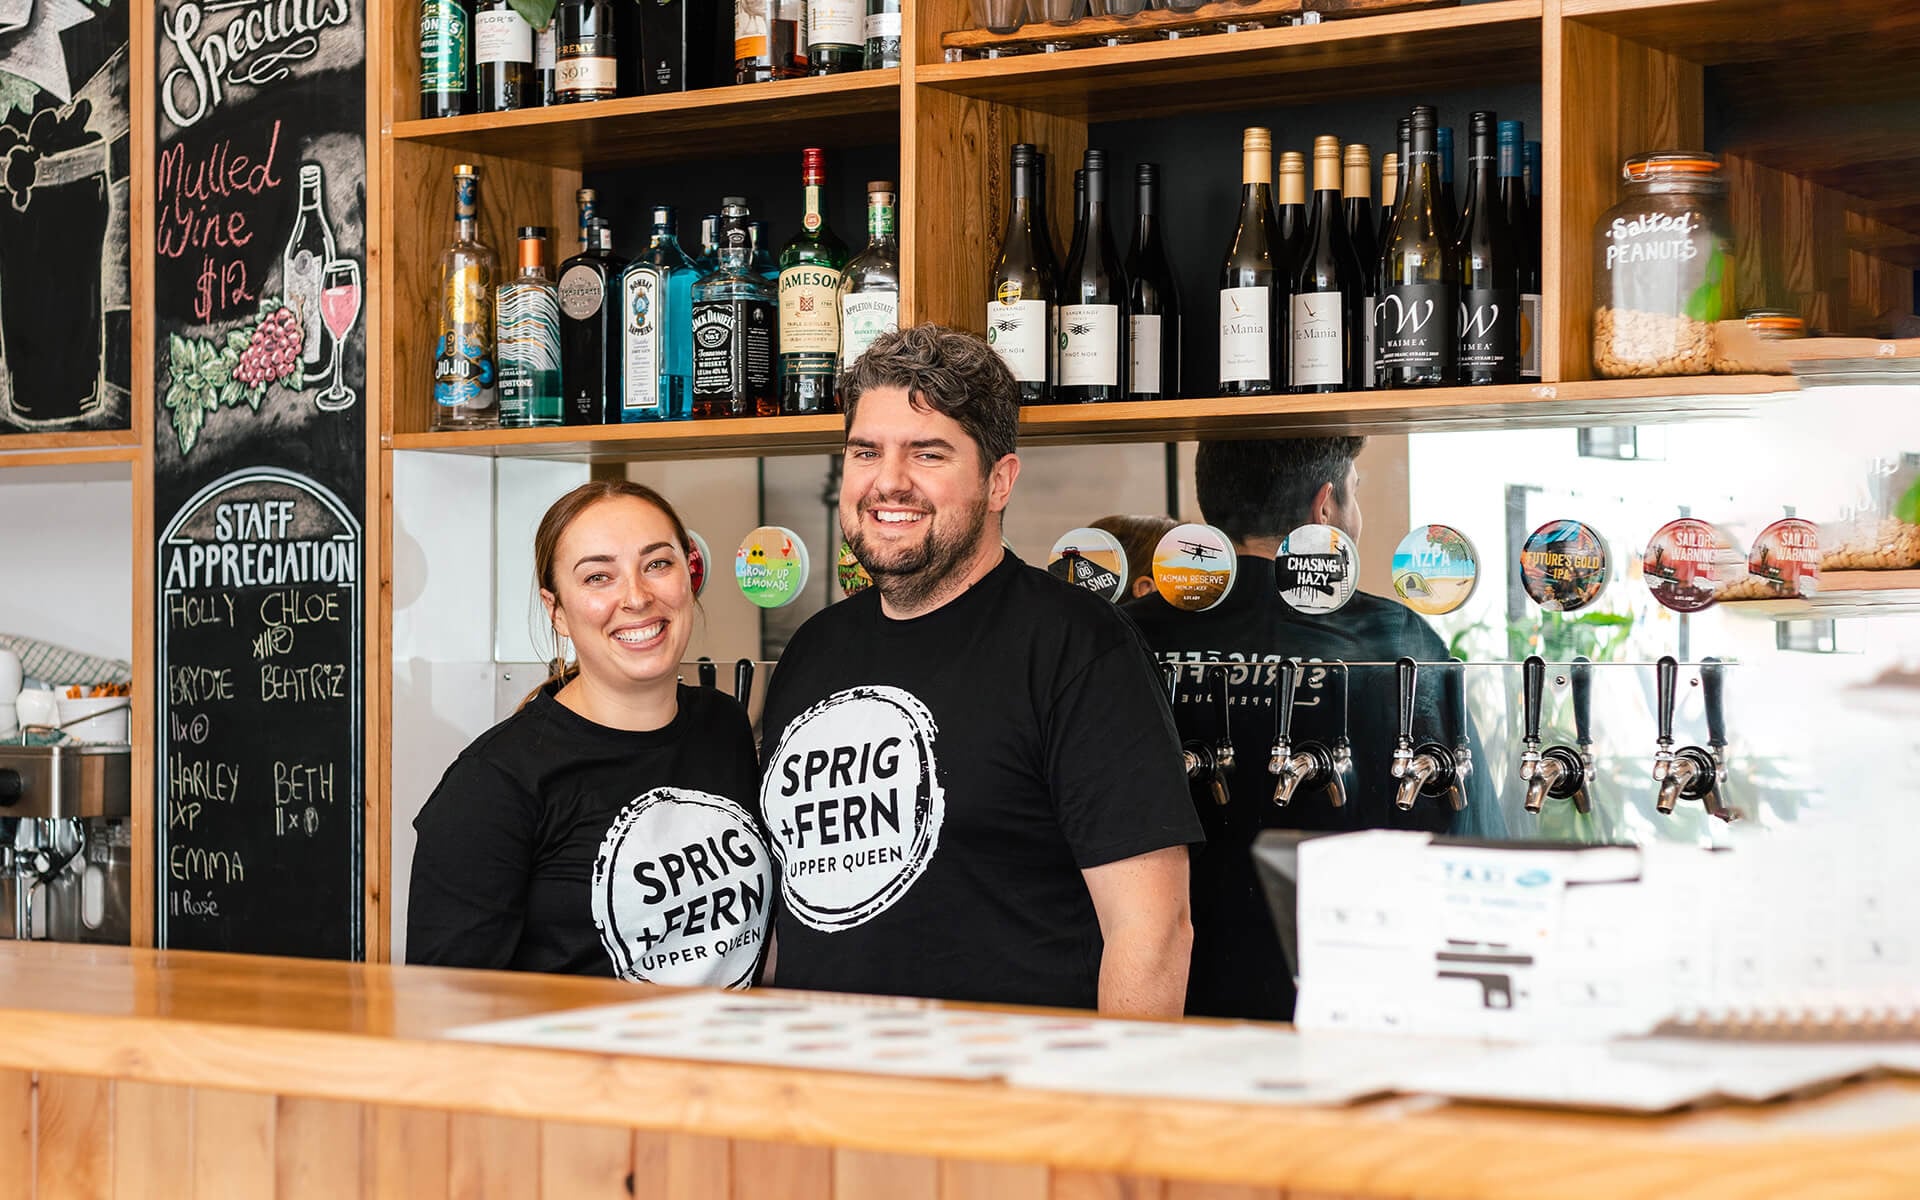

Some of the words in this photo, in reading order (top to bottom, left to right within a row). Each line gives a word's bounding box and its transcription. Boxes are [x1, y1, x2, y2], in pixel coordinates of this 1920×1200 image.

[162, 0, 349, 127] Specials
[158, 120, 281, 201] Mulled
[157, 201, 253, 257] Wine
[1611, 212, 1690, 240] Salted
[1606, 240, 1697, 270] PEANUTS
[194, 254, 254, 325] $12
[781, 272, 838, 293] JAMESON
[845, 303, 873, 317] APPLETON
[873, 300, 896, 315] ESTATE
[1230, 323, 1264, 335] Mania
[1303, 328, 1337, 340] Mania
[215, 500, 295, 542] STAFF
[164, 541, 355, 588] APPRECIATION
[1287, 556, 1337, 572] CHASING
[1411, 545, 1451, 568] NZPA
[1526, 550, 1573, 568] FUTURE'S
[1574, 554, 1600, 569] GOLD
[743, 576, 789, 592] LEMONADE
[777, 568, 789, 580] UP
[1158, 573, 1188, 584] TASMAN
[1189, 575, 1224, 585] RESERVE
[1297, 571, 1330, 587] HAZY
[1553, 567, 1570, 580] IPA
[170, 591, 236, 630] HOLLY
[260, 588, 341, 627] CHLOE
[169, 752, 240, 804] HARLEY
[274, 760, 333, 806] BETH
[780, 736, 902, 798] SPRIG
[170, 844, 245, 884] EMMA
[632, 828, 757, 905] SPRIG
[789, 857, 837, 878] UPPER
[843, 845, 903, 872] QUEEN
[641, 944, 709, 971] UPPER
[714, 926, 762, 958] QUEEN
